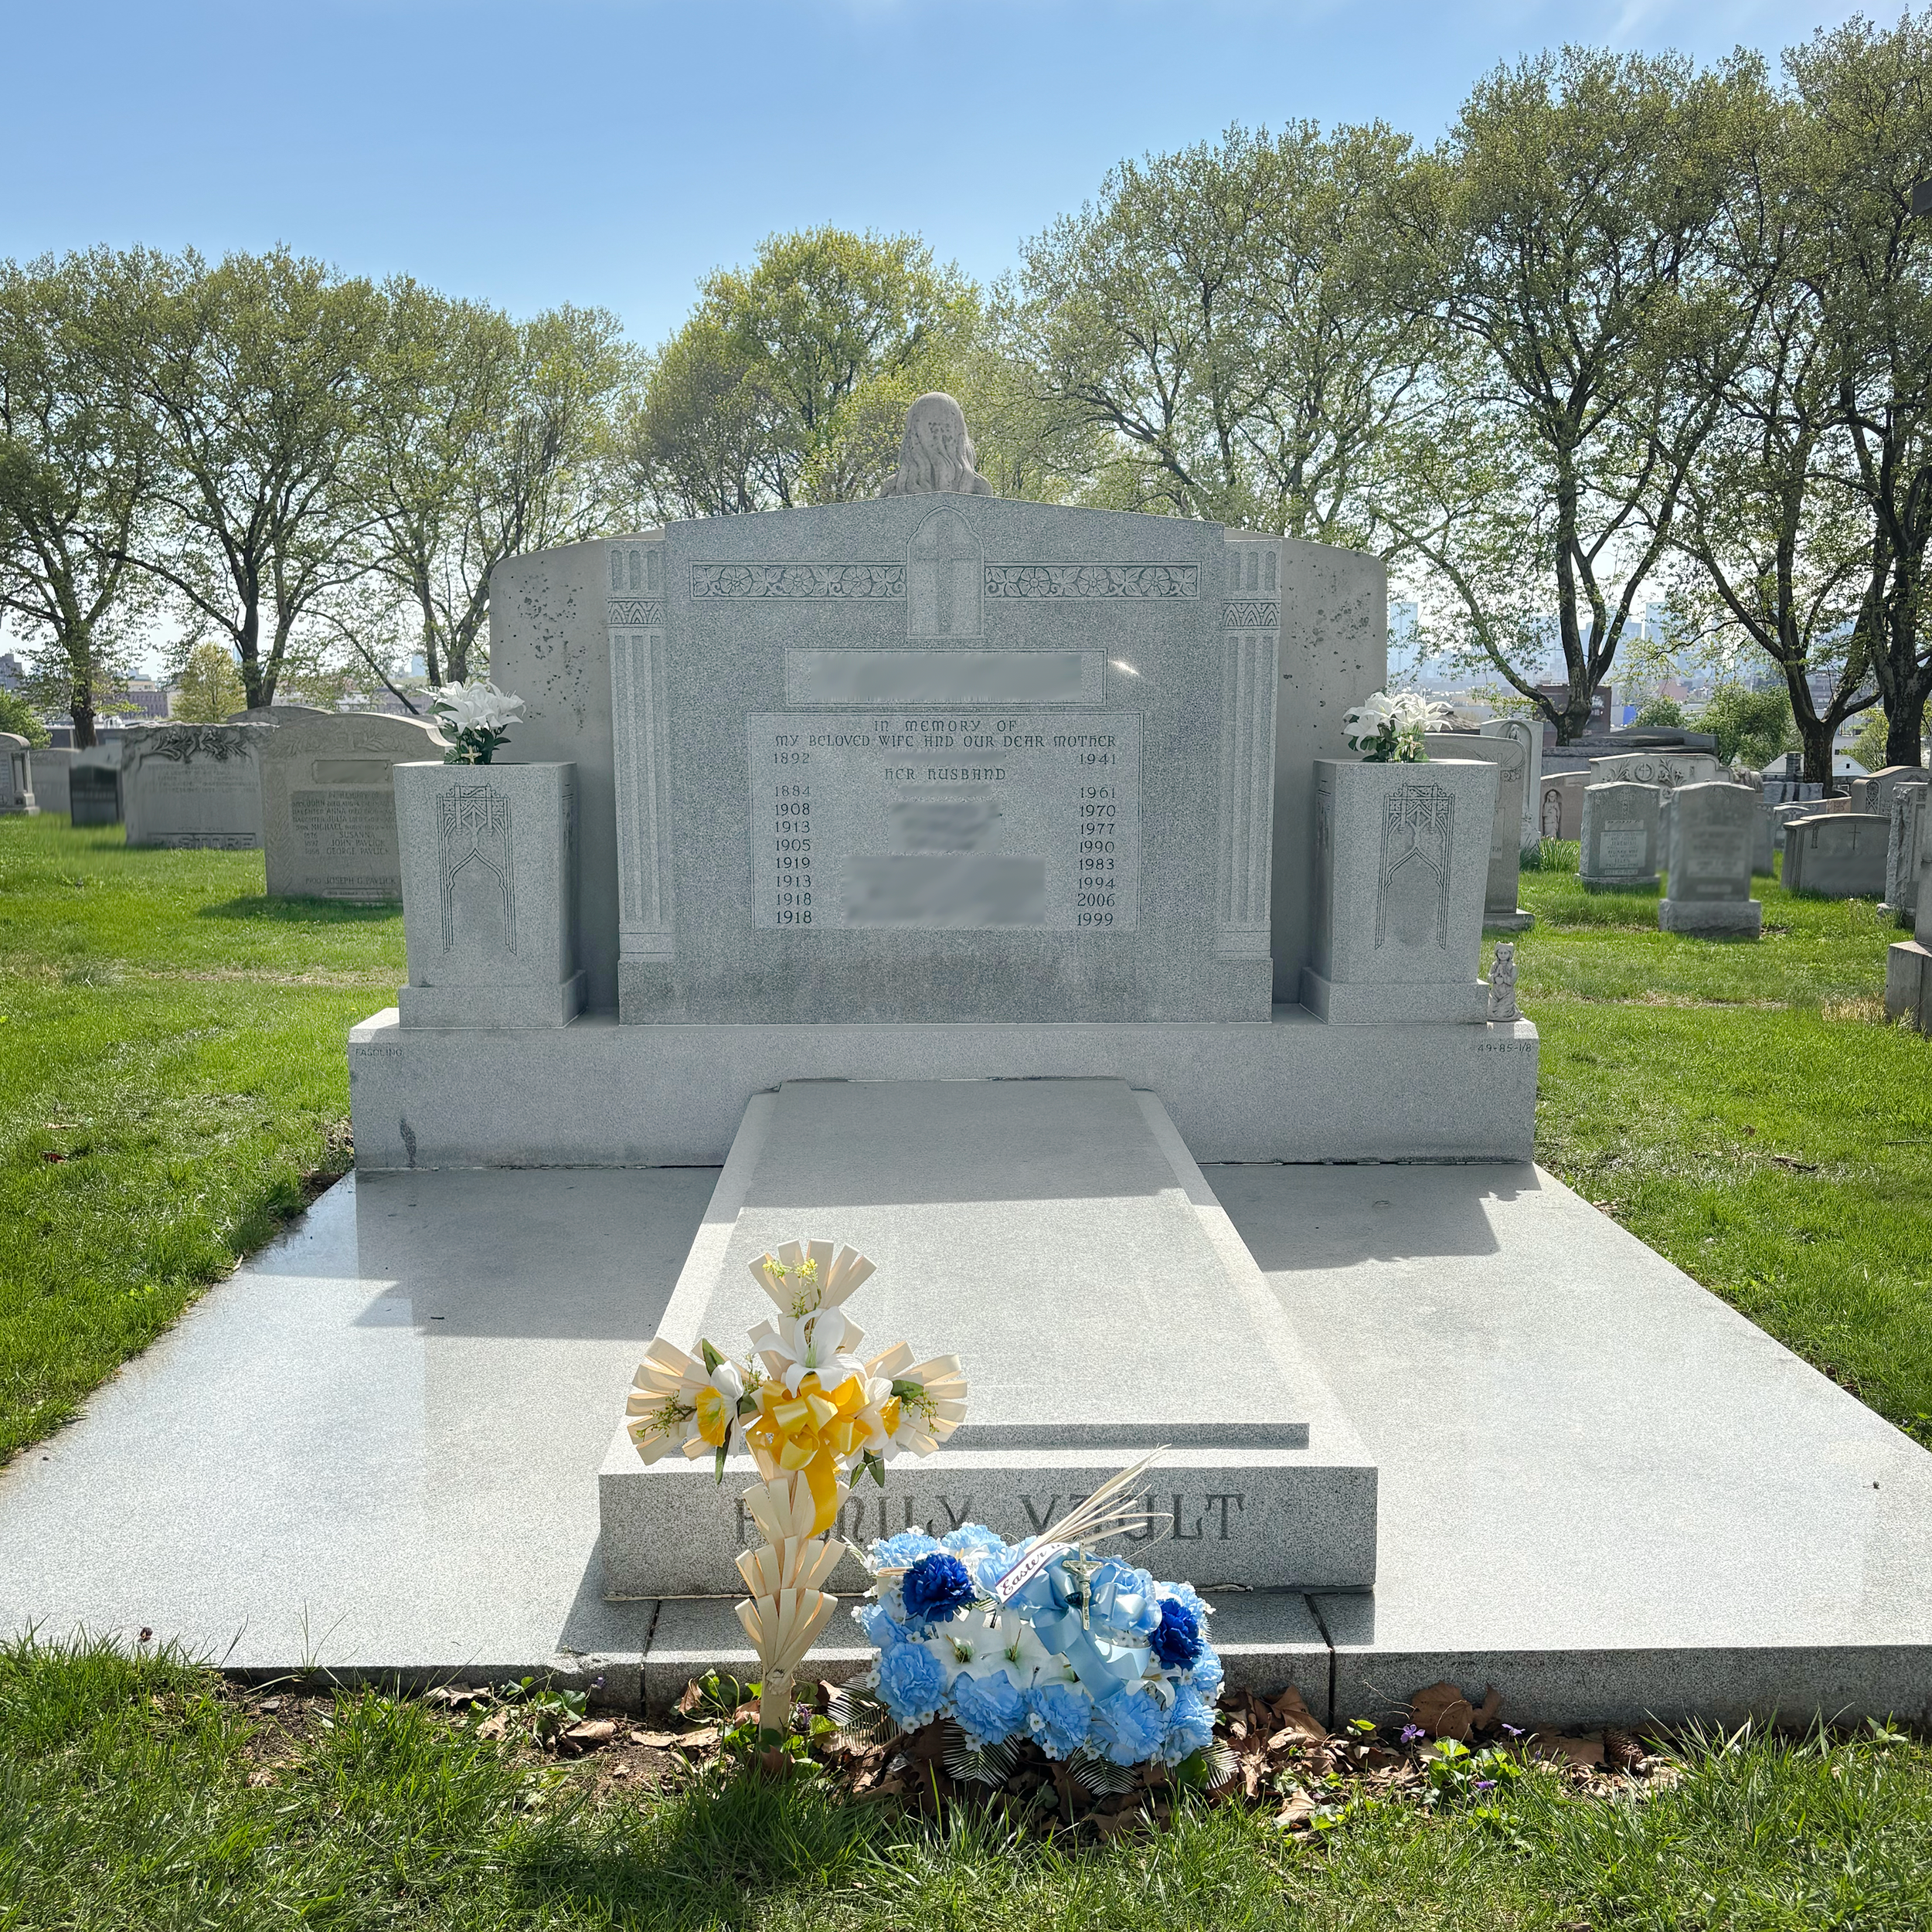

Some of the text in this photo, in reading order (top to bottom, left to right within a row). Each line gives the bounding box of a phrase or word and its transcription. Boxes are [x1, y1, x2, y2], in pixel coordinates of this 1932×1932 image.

[874, 720, 1017, 732] IN MEMORY OF
[775, 735, 1116, 747] MY BELOVED WIFE AND OUR DEAR MOTHER
[774, 753, 1116, 765] 1892 1941
[885, 768, 1005, 781] HER HUSBAND
[775, 785, 1116, 798] 1884 1961
[775, 803, 1116, 817] 1908 1970
[775, 821, 1115, 835] 1913 1977
[776, 839, 1114, 853] 1905 1990
[776, 857, 1114, 870] 1919 1983
[777, 875, 1116, 889] 1913 1994
[777, 893, 1115, 906] 1918 2006
[777, 910, 1114, 926] 1918 1999
[734, 1495, 975, 1544] FMILY
[1001, 1550, 1047, 1596] Easter
